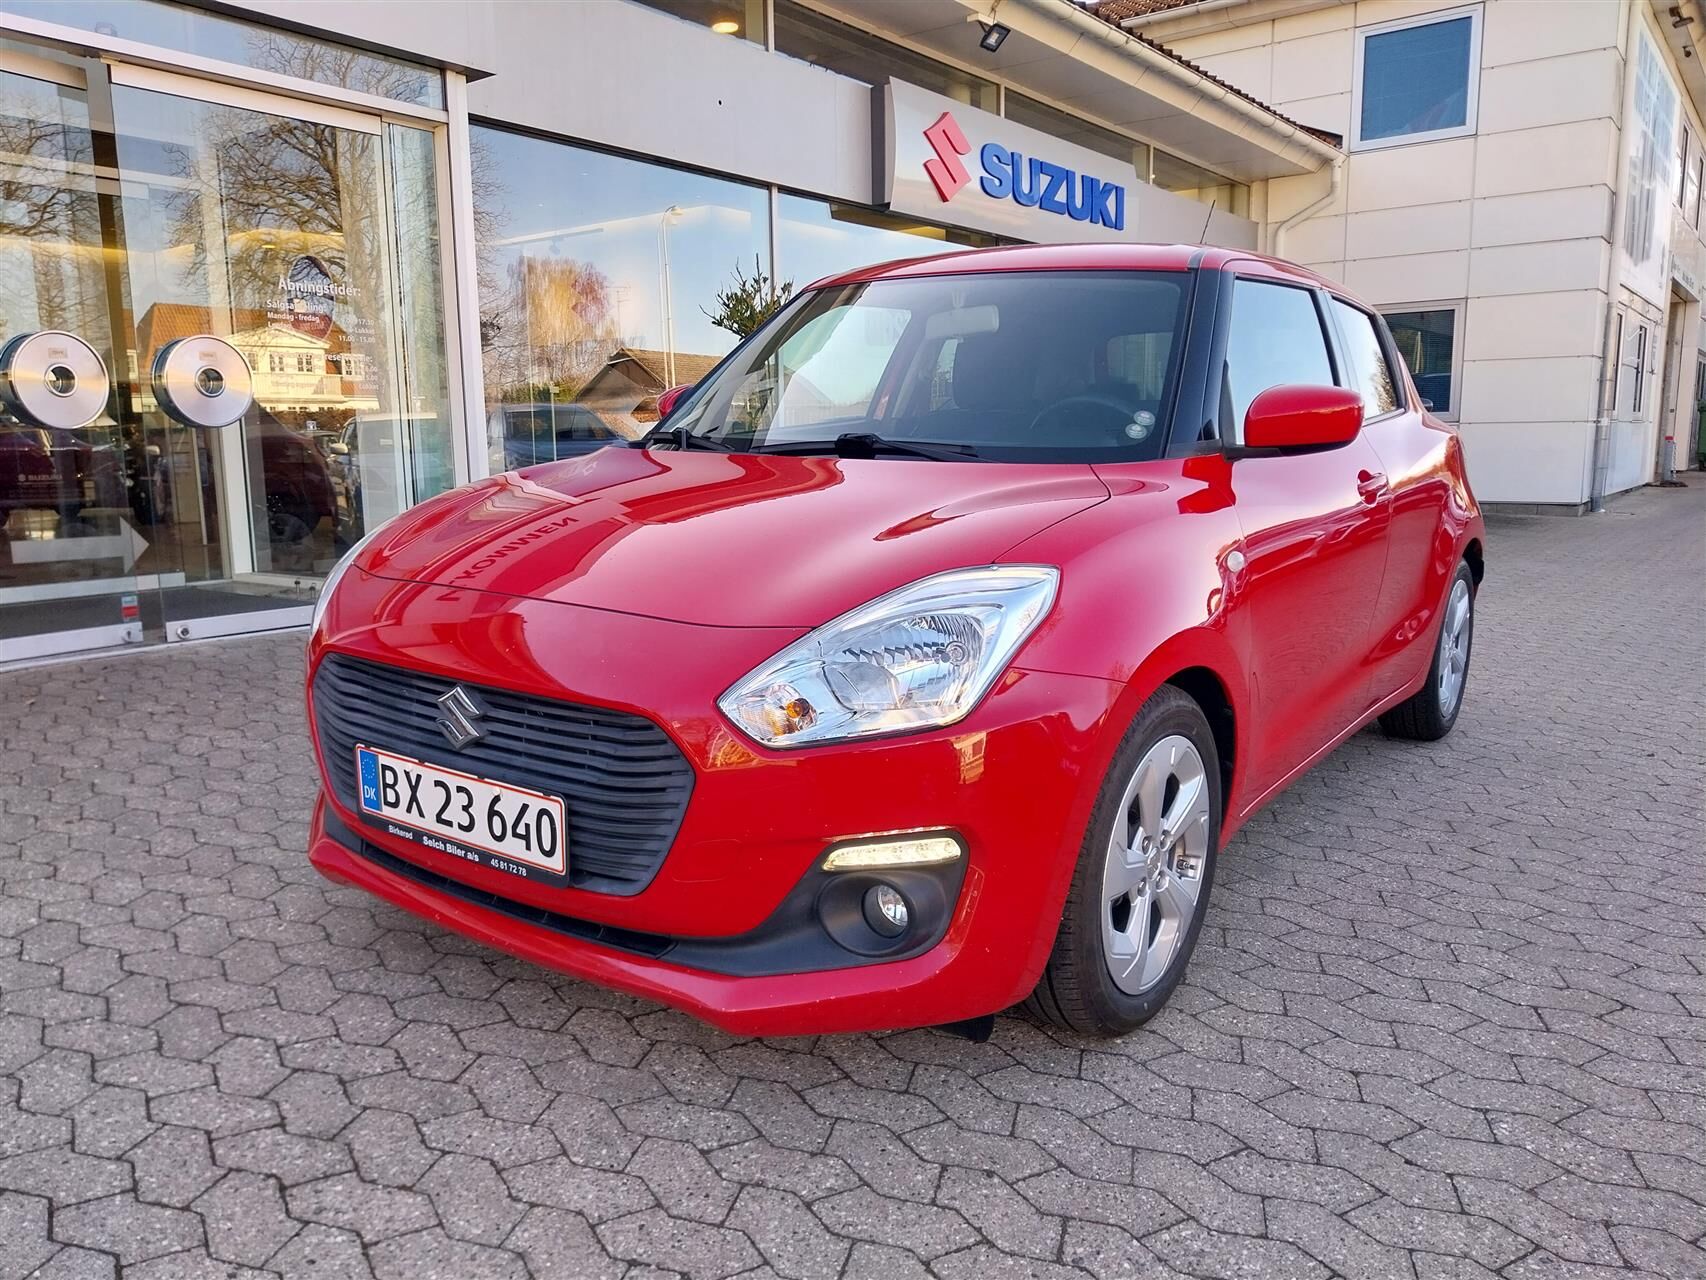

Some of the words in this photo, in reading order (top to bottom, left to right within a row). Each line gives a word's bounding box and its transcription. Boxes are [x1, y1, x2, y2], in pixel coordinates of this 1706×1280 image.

[980, 143, 1124, 231] SUZUKI
[267, 311, 294, 321] Mandag
[298, 313, 320, 323] fredag
[364, 785, 377, 801] DK
[381, 763, 425, 818] BX
[433, 780, 476, 833] 23
[487, 794, 557, 858] 640
[446, 843, 466, 857] Biler
[490, 858, 499, 868] 45
[499, 860, 508, 871] 81
[508, 863, 518, 874] 72
[518, 866, 527, 877] 78
